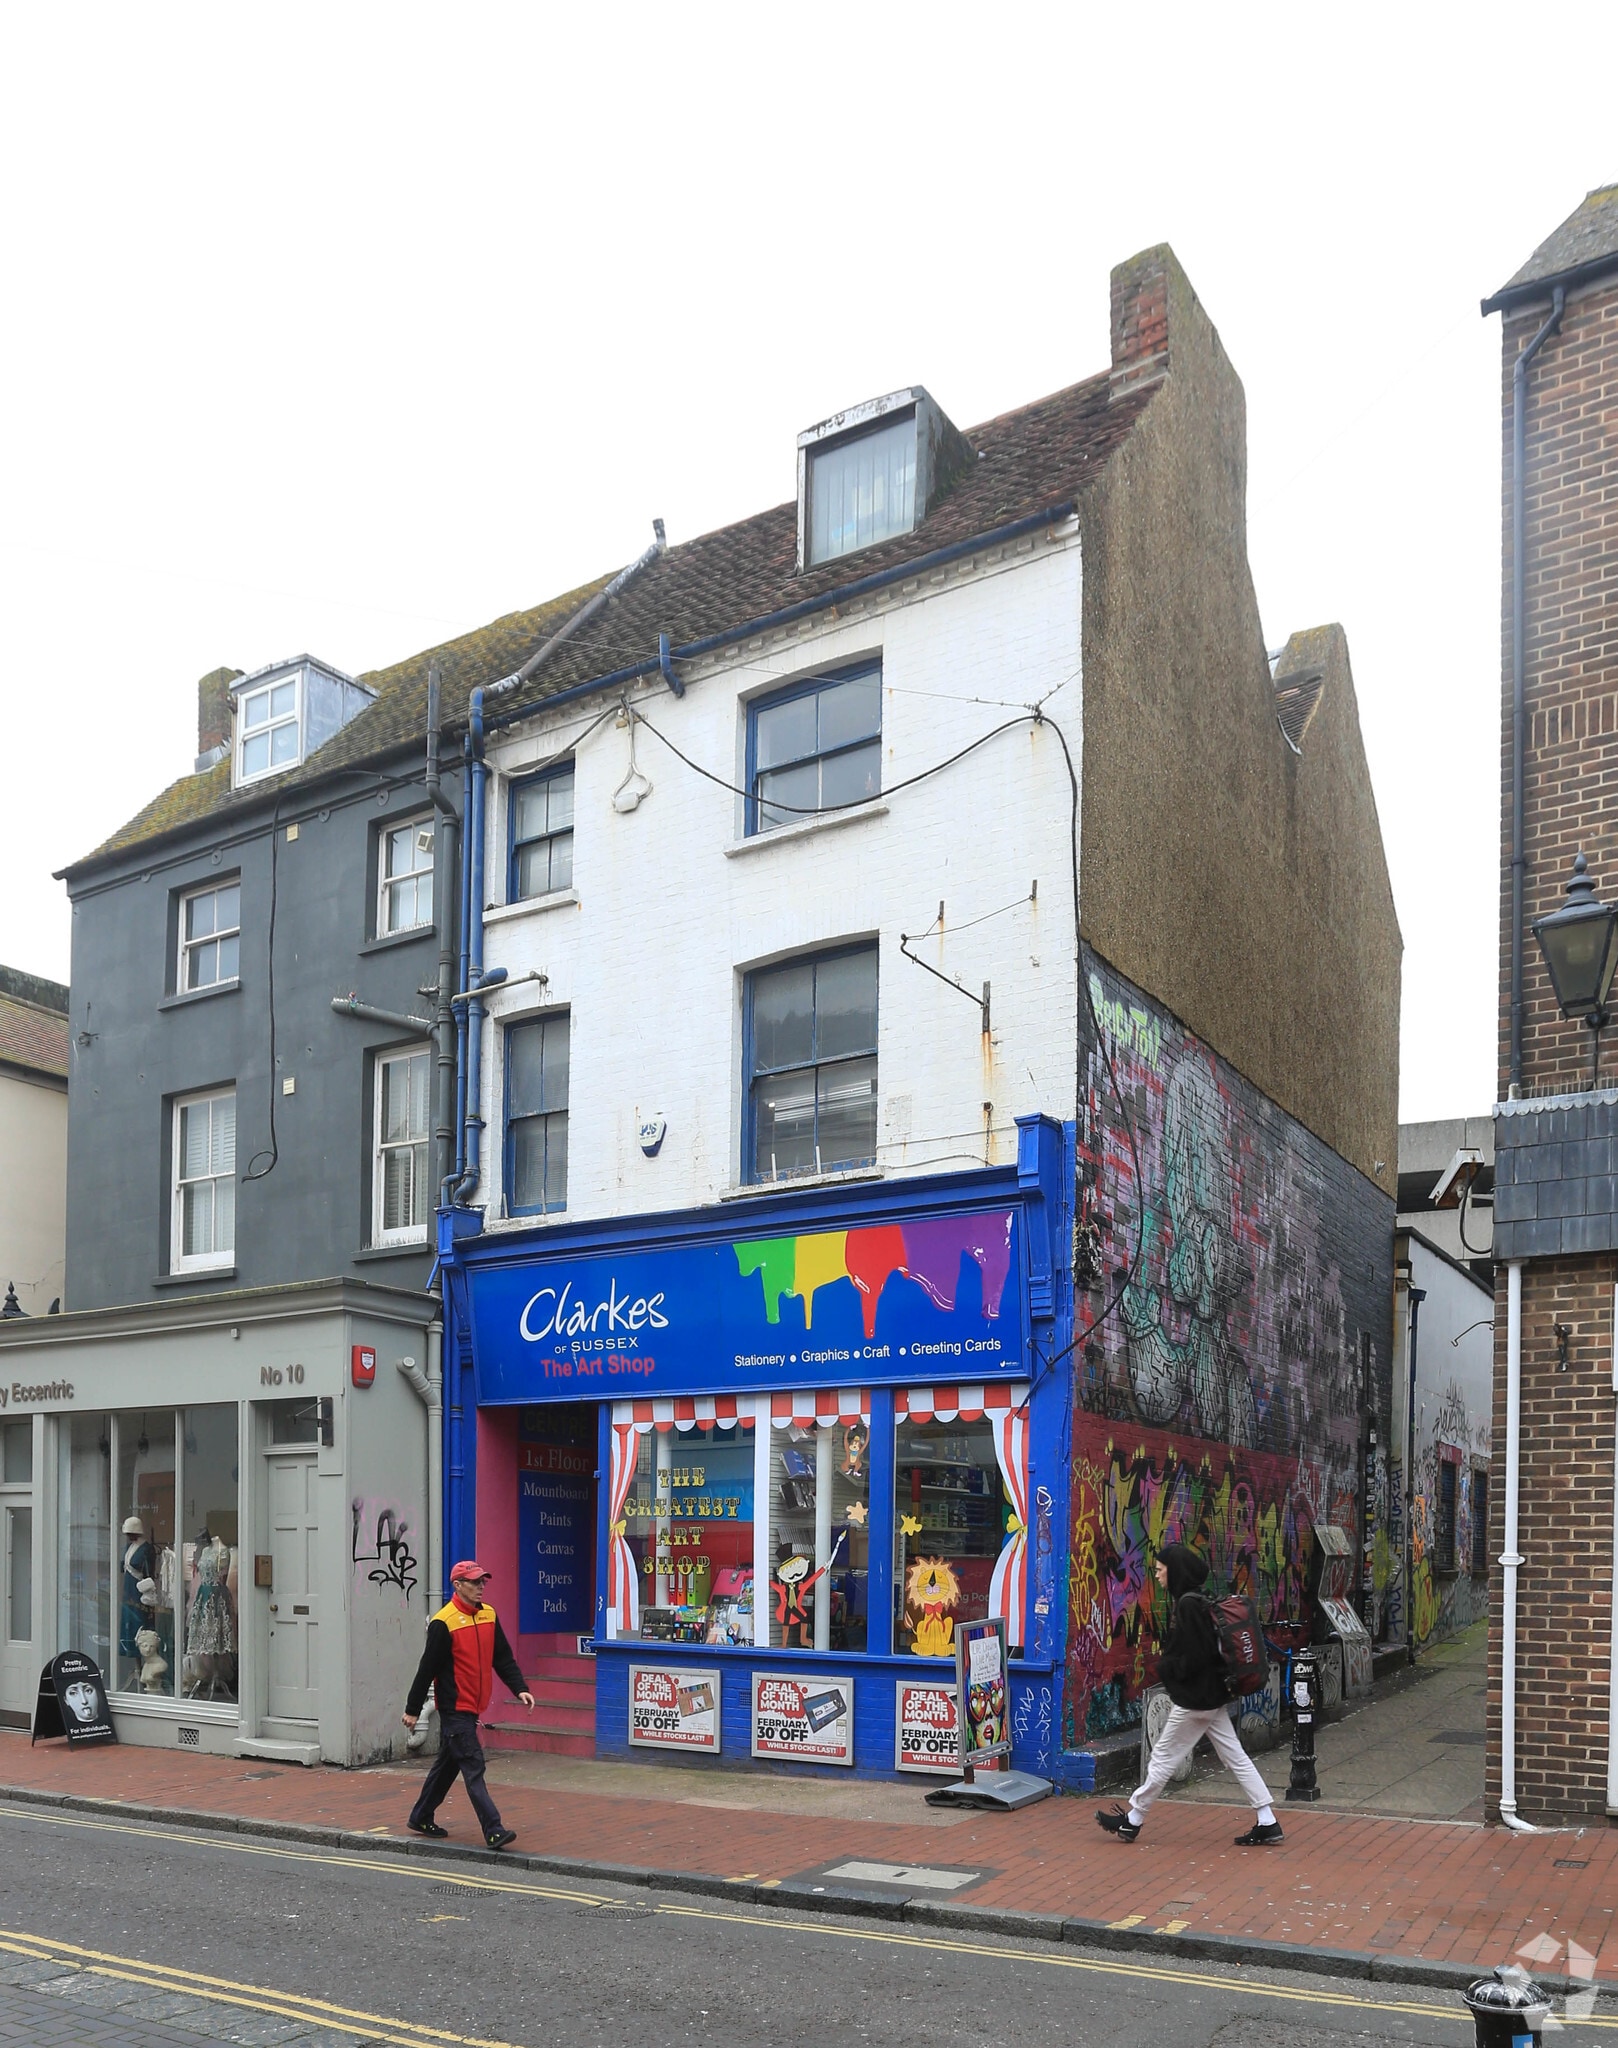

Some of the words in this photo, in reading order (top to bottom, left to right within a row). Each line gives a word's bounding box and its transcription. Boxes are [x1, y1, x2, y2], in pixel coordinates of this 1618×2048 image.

[519, 1277, 669, 1342] Clarkes
[554, 1346, 567, 1354] OF
[571, 1337, 639, 1352] SUSSEX
[734, 1354, 786, 1367] Stationery
[801, 1349, 850, 1364] Graphics
[863, 1345, 891, 1358] Craft
[911, 1341, 961, 1355] Greeting
[964, 1338, 1001, 1352] Cards
[541, 1358, 573, 1378] The
[577, 1358, 603, 1376] Art
[607, 1354, 655, 1376] Shop
[260, 1366, 282, 1385] No
[286, 1363, 305, 1384] 10
[12, 1379, 75, 1403] Eccentric
[526, 1449, 544, 1468] 1st
[548, 1448, 589, 1473] Floor
[658, 1467, 705, 1488] THE
[523, 1481, 589, 1501] Mountboard
[623, 1496, 740, 1517] GREATEST
[539, 1511, 572, 1527] Paints
[656, 1526, 705, 1546] ART
[537, 1540, 574, 1555] Canvas
[643, 1555, 711, 1575] SHOP
[538, 1570, 573, 1588] Papers
[543, 1599, 567, 1613] Pads
[61, 1665, 88, 1673] Eccentric
[64, 1659, 82, 1667] Pretty
[641, 1673, 667, 1684] DEAL
[637, 1683, 651, 1691] OF
[653, 1683, 672, 1693] THE
[766, 1682, 794, 1693] DEAL
[636, 1690, 672, 1702] MONTH
[761, 1691, 777, 1700] OF
[779, 1692, 799, 1702] THE
[911, 1690, 942, 1700] DEAL
[760, 1700, 800, 1711] MONTH
[905, 1700, 922, 1710] OF
[924, 1701, 948, 1711] THE
[634, 1707, 679, 1718] FEBRUARY
[904, 1710, 948, 1721] MONTH
[653, 1717, 680, 1730] OFF
[758, 1717, 808, 1729] FEBRUARY
[642, 1730, 662, 1738] WHILE
[663, 1732, 687, 1740] STOCKS
[687, 1734, 705, 1742] LAST!
[779, 1727, 808, 1741] OFF
[902, 1729, 958, 1740] FEBRUARY
[790, 1744, 816, 1752] STOCKS
[817, 1746, 836, 1754] LAST!
[926, 1739, 958, 1754] OFF
[912, 1753, 937, 1762] WHILE
[938, 1755, 958, 1763] STOC
